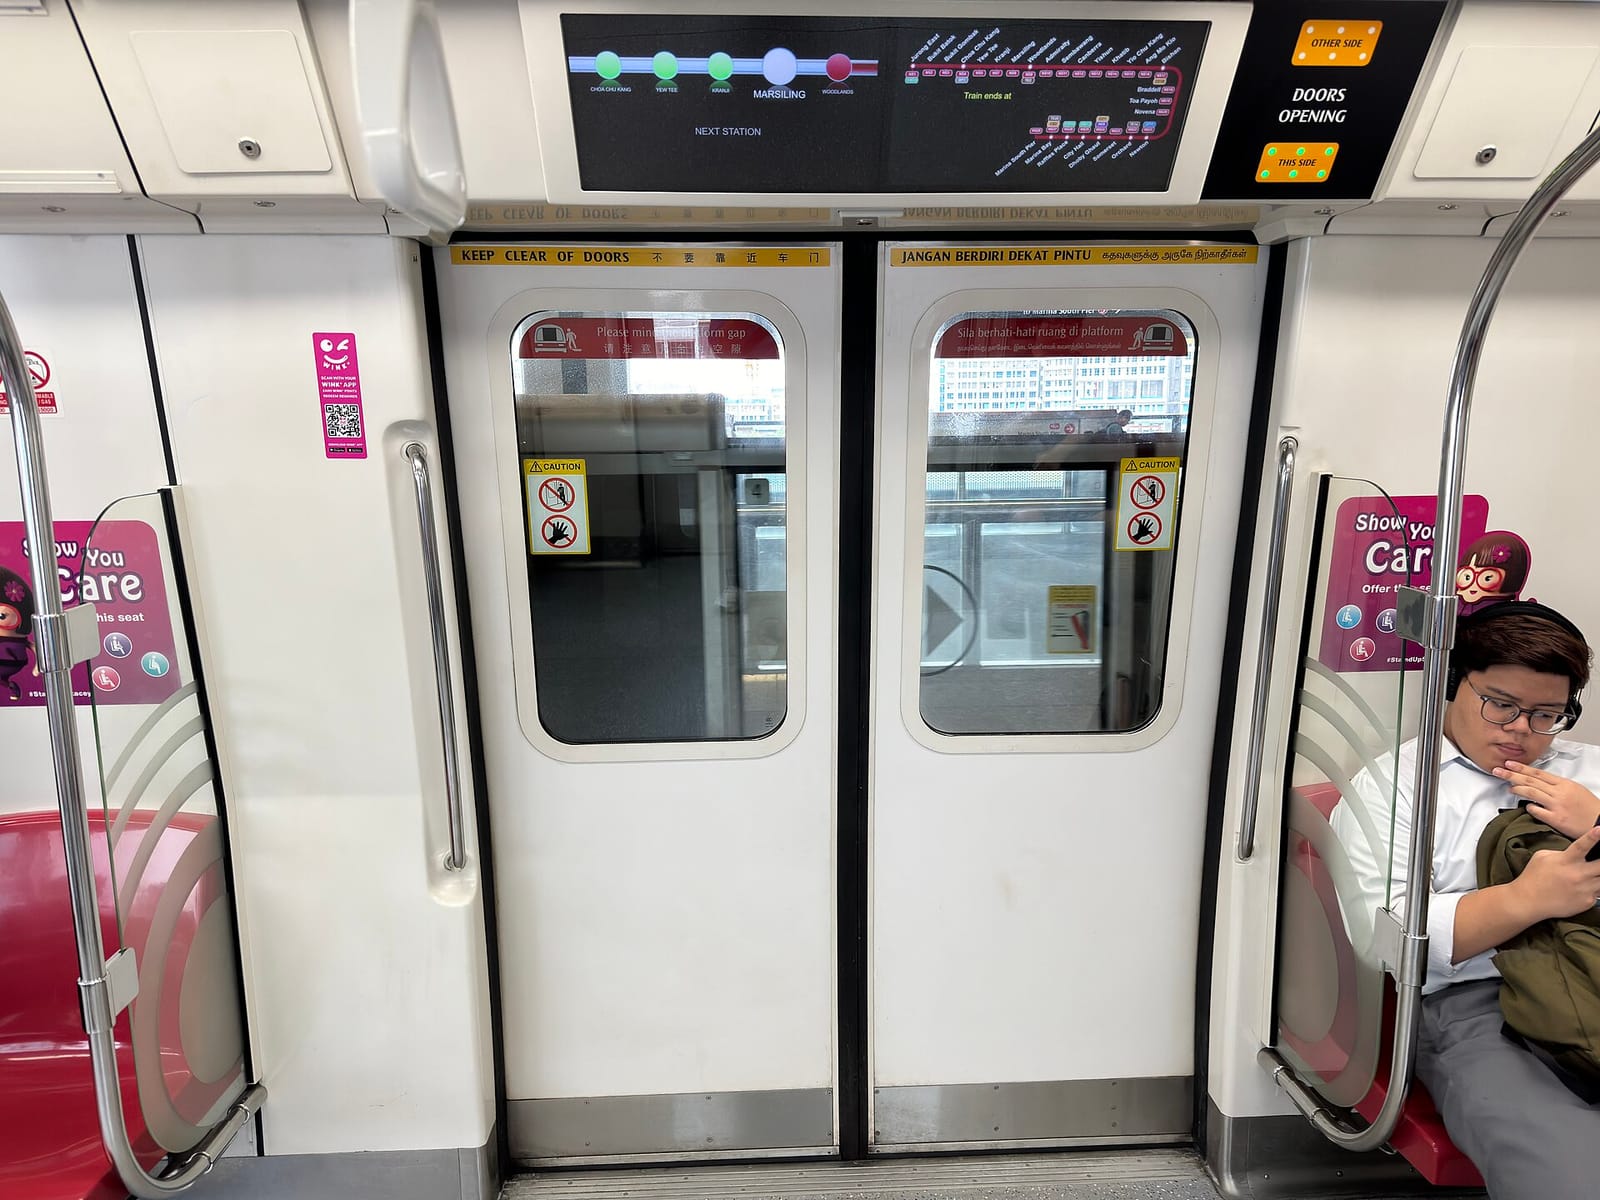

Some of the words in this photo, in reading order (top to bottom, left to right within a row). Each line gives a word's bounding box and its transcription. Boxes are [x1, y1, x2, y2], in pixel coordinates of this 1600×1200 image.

[1311, 39, 1341, 48] OTHER
[1343, 39, 1363, 48] SIDE
[752, 89, 807, 99] MARSILING
[963, 92, 982, 100] Train
[984, 92, 1001, 100] ends
[1003, 92, 1012, 100] at
[1292, 88, 1347, 102] DOORS
[1278, 109, 1347, 123] OPENING
[694, 127, 720, 136] NEXT
[722, 127, 762, 136] STATION
[1278, 159, 1296, 167] THIS
[1298, 159, 1317, 167] SIDE
[461, 250, 495, 261] KEEP
[505, 250, 547, 262] CLEAR
[557, 251, 574, 262] OF
[583, 251, 630, 263] DOORS
[653, 251, 820, 263] 不要靠近车门
[901, 250, 951, 263] JANGAN
[956, 250, 1004, 262] BERDIRI
[1009, 249, 1049, 261] DEKAT
[1054, 249, 1092, 261] PINTU
[1102, 250, 1159, 262] கதவுகளுக்கு
[1162, 249, 1193, 261] அருகே
[1195, 248, 1247, 260] நிற்காதீர்கள்
[597, 326, 629, 337] Please
[632, 326, 658, 337] min
[727, 328, 746, 339] gap
[958, 327, 975, 338] Sila
[977, 326, 1035, 338] berhati-hati
[1038, 328, 1067, 339] ruang
[1069, 325, 1079, 336] di
[1081, 325, 1124, 338] platform
[543, 462, 581, 471] CAUTION
[1139, 460, 1175, 469] CAUTION
[1355, 513, 1407, 531] Show
[87, 549, 125, 567] You
[1366, 541, 1434, 573] Car
[58, 568, 143, 601] Care
[1362, 584, 1392, 593] Offer
[97, 612, 115, 622] his
[118, 612, 145, 622] seat
